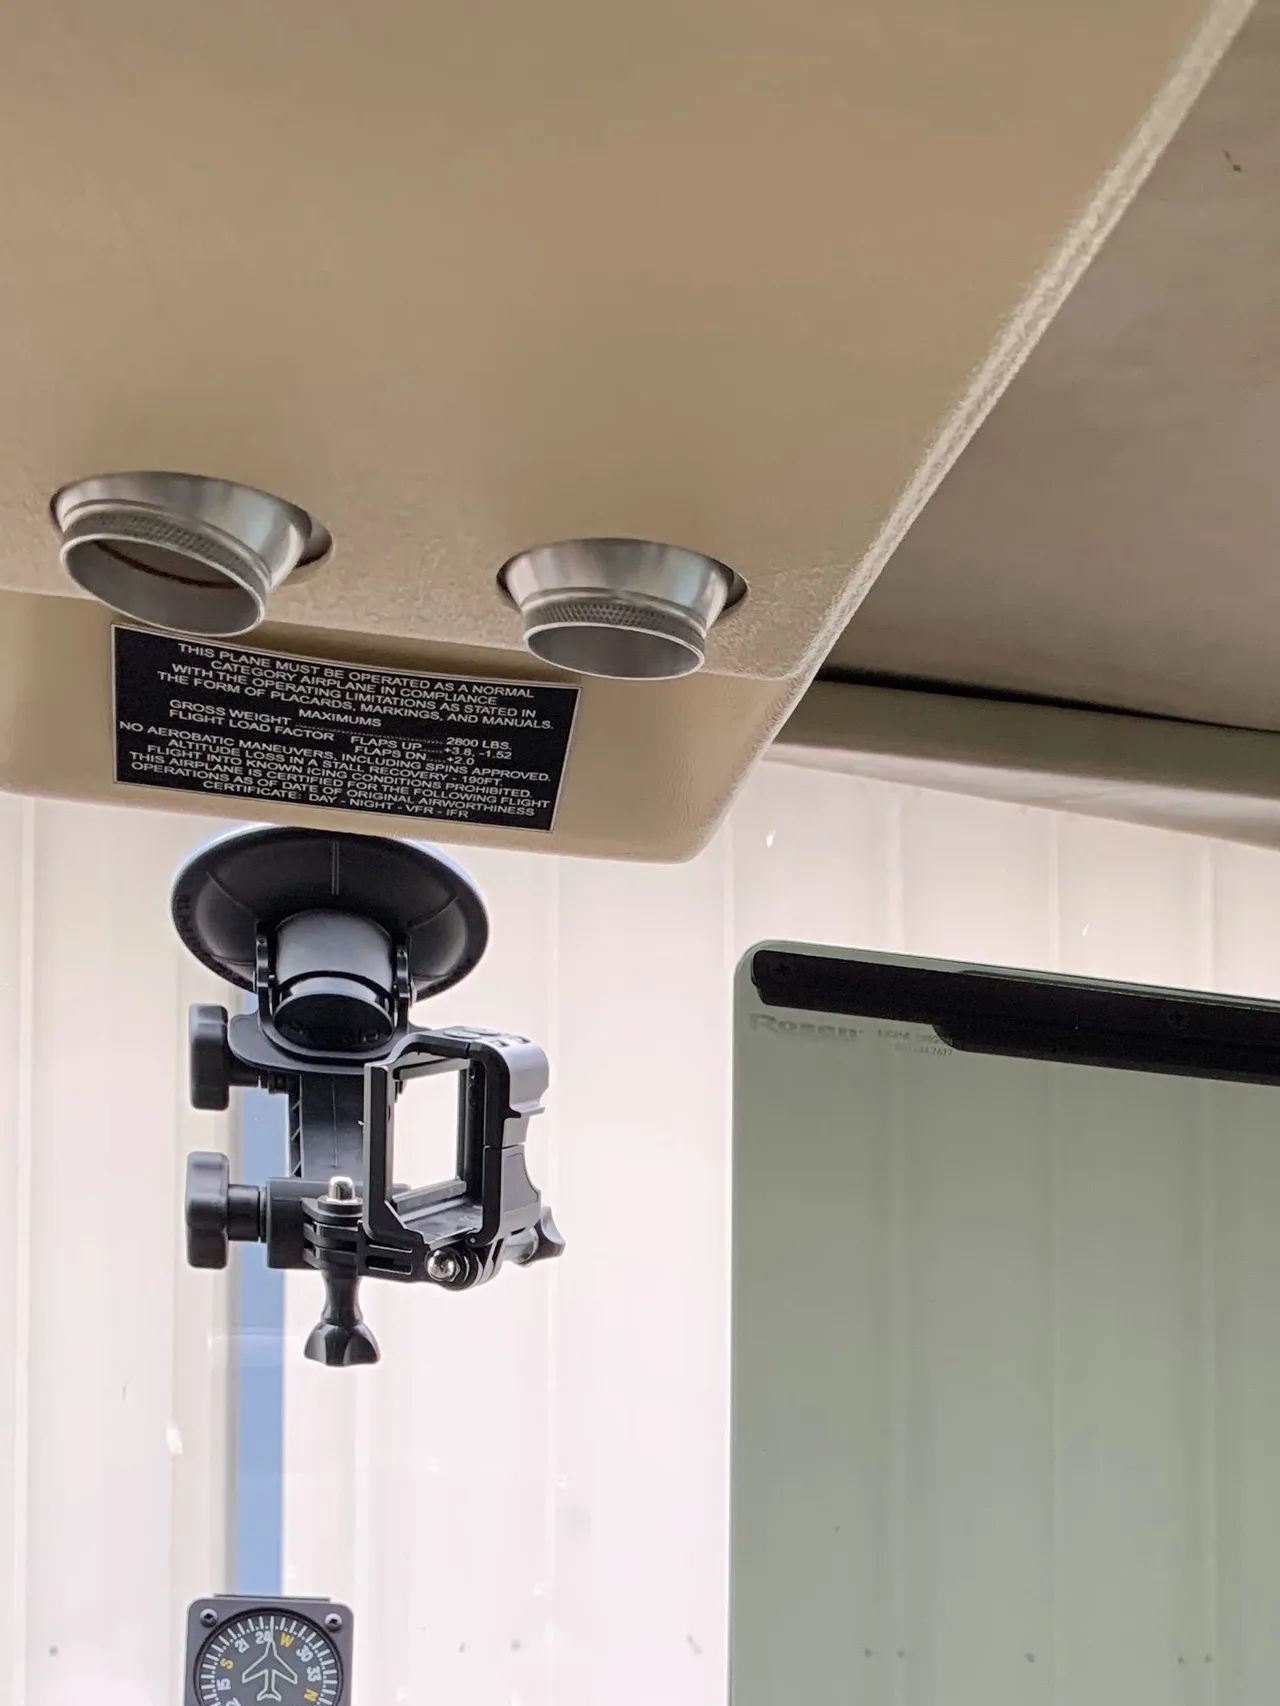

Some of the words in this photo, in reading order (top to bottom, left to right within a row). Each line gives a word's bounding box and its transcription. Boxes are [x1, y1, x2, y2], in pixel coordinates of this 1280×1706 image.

[178, 643, 214, 658] THIS
[220, 651, 270, 667] PLANE
[275, 661, 319, 675] MUST
[324, 669, 344, 679] BE
[349, 671, 430, 689] OPERATED
[434, 681, 454, 692] AS
[458, 683, 469, 693] A
[472, 685, 534, 698] NORMAL
[172, 663, 213, 678] WITH
[219, 671, 247, 685] THE
[252, 678, 341, 699] OPERATING
[346, 691, 436, 709] LIMITATIONS
[440, 701, 460, 712] AS
[464, 703, 517, 717] STATED
[521, 709, 536, 718] IN
[211, 661, 296, 680] CATEGORY
[300, 673, 376, 693] AIRPLANE
[381, 685, 395, 696] IN
[400, 688, 498, 706] COMPLIANCE
[157, 671, 189, 686] THE
[194, 678, 240, 694] FORM
[244, 686, 266, 697] OF
[447, 712, 478, 724] AND
[482, 716, 554, 730] MANUALS.
[169, 699, 226, 716] GROSS
[229, 709, 292, 725] WEIGHT
[446, 737, 478, 748] 2800
[482, 740, 512, 751] LBS.
[298, 709, 382, 728] MAXIMUMS
[234, 1638, 250, 1654] 21
[280, 1632, 294, 1647] W
[296, 1644, 314, 1662] 30
[219, 1658, 234, 1669] S
[306, 1665, 321, 1682] 33
[216, 1678, 231, 1690] 15
[303, 1688, 319, 1703] N
